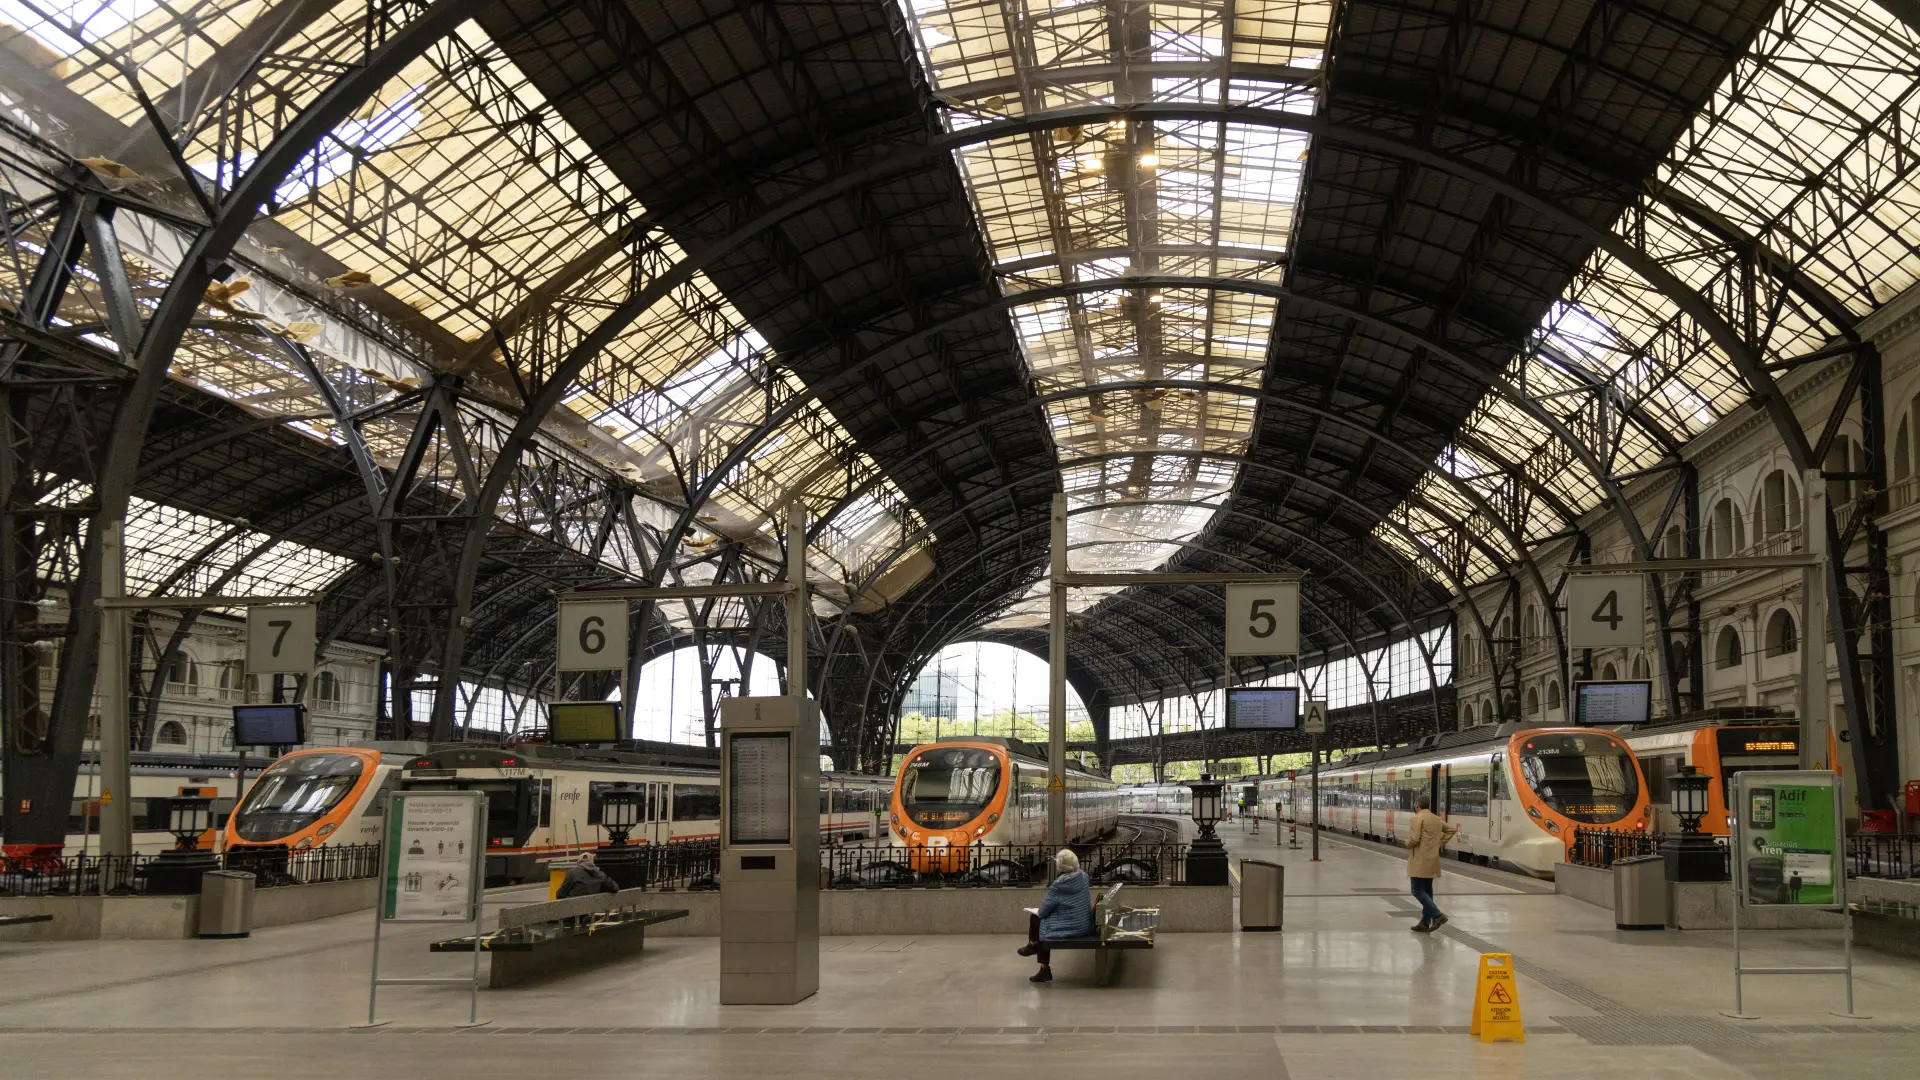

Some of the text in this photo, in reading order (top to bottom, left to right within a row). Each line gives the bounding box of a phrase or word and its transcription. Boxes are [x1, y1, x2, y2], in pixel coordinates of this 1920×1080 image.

[1248, 598, 1277, 638] 5
[1591, 589, 1623, 631] 4
[267, 620, 293, 657] 7
[579, 615, 606, 654] 6
[1307, 705, 1322, 722] A
[504, 767, 526, 776] 117M
[1211, 765, 1217, 773] 5
[560, 788, 581, 805] renfe
[1779, 789, 1807, 801] Adif
[360, 823, 380, 835] renfe
[926, 835, 949, 857] R
[1760, 845, 1783, 855] Tren
[1766, 840, 1798, 848] Situación
